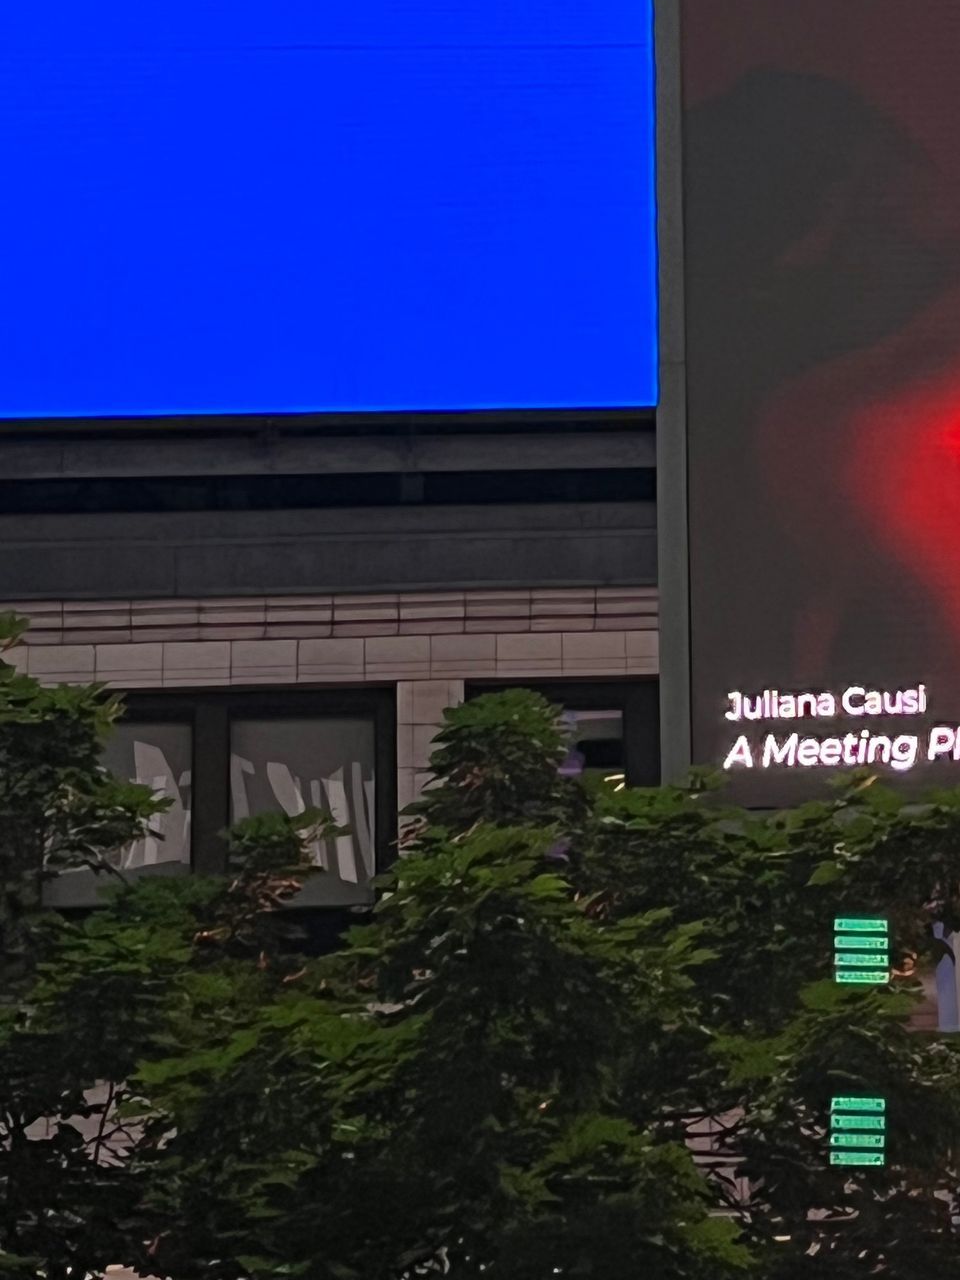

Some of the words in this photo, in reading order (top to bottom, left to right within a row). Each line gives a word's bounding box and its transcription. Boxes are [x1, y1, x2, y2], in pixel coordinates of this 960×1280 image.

[725, 690, 836, 721] Juliana
[842, 685, 926, 716] Causi
[723, 735, 754, 770] A
[762, 730, 918, 771] Meeting
